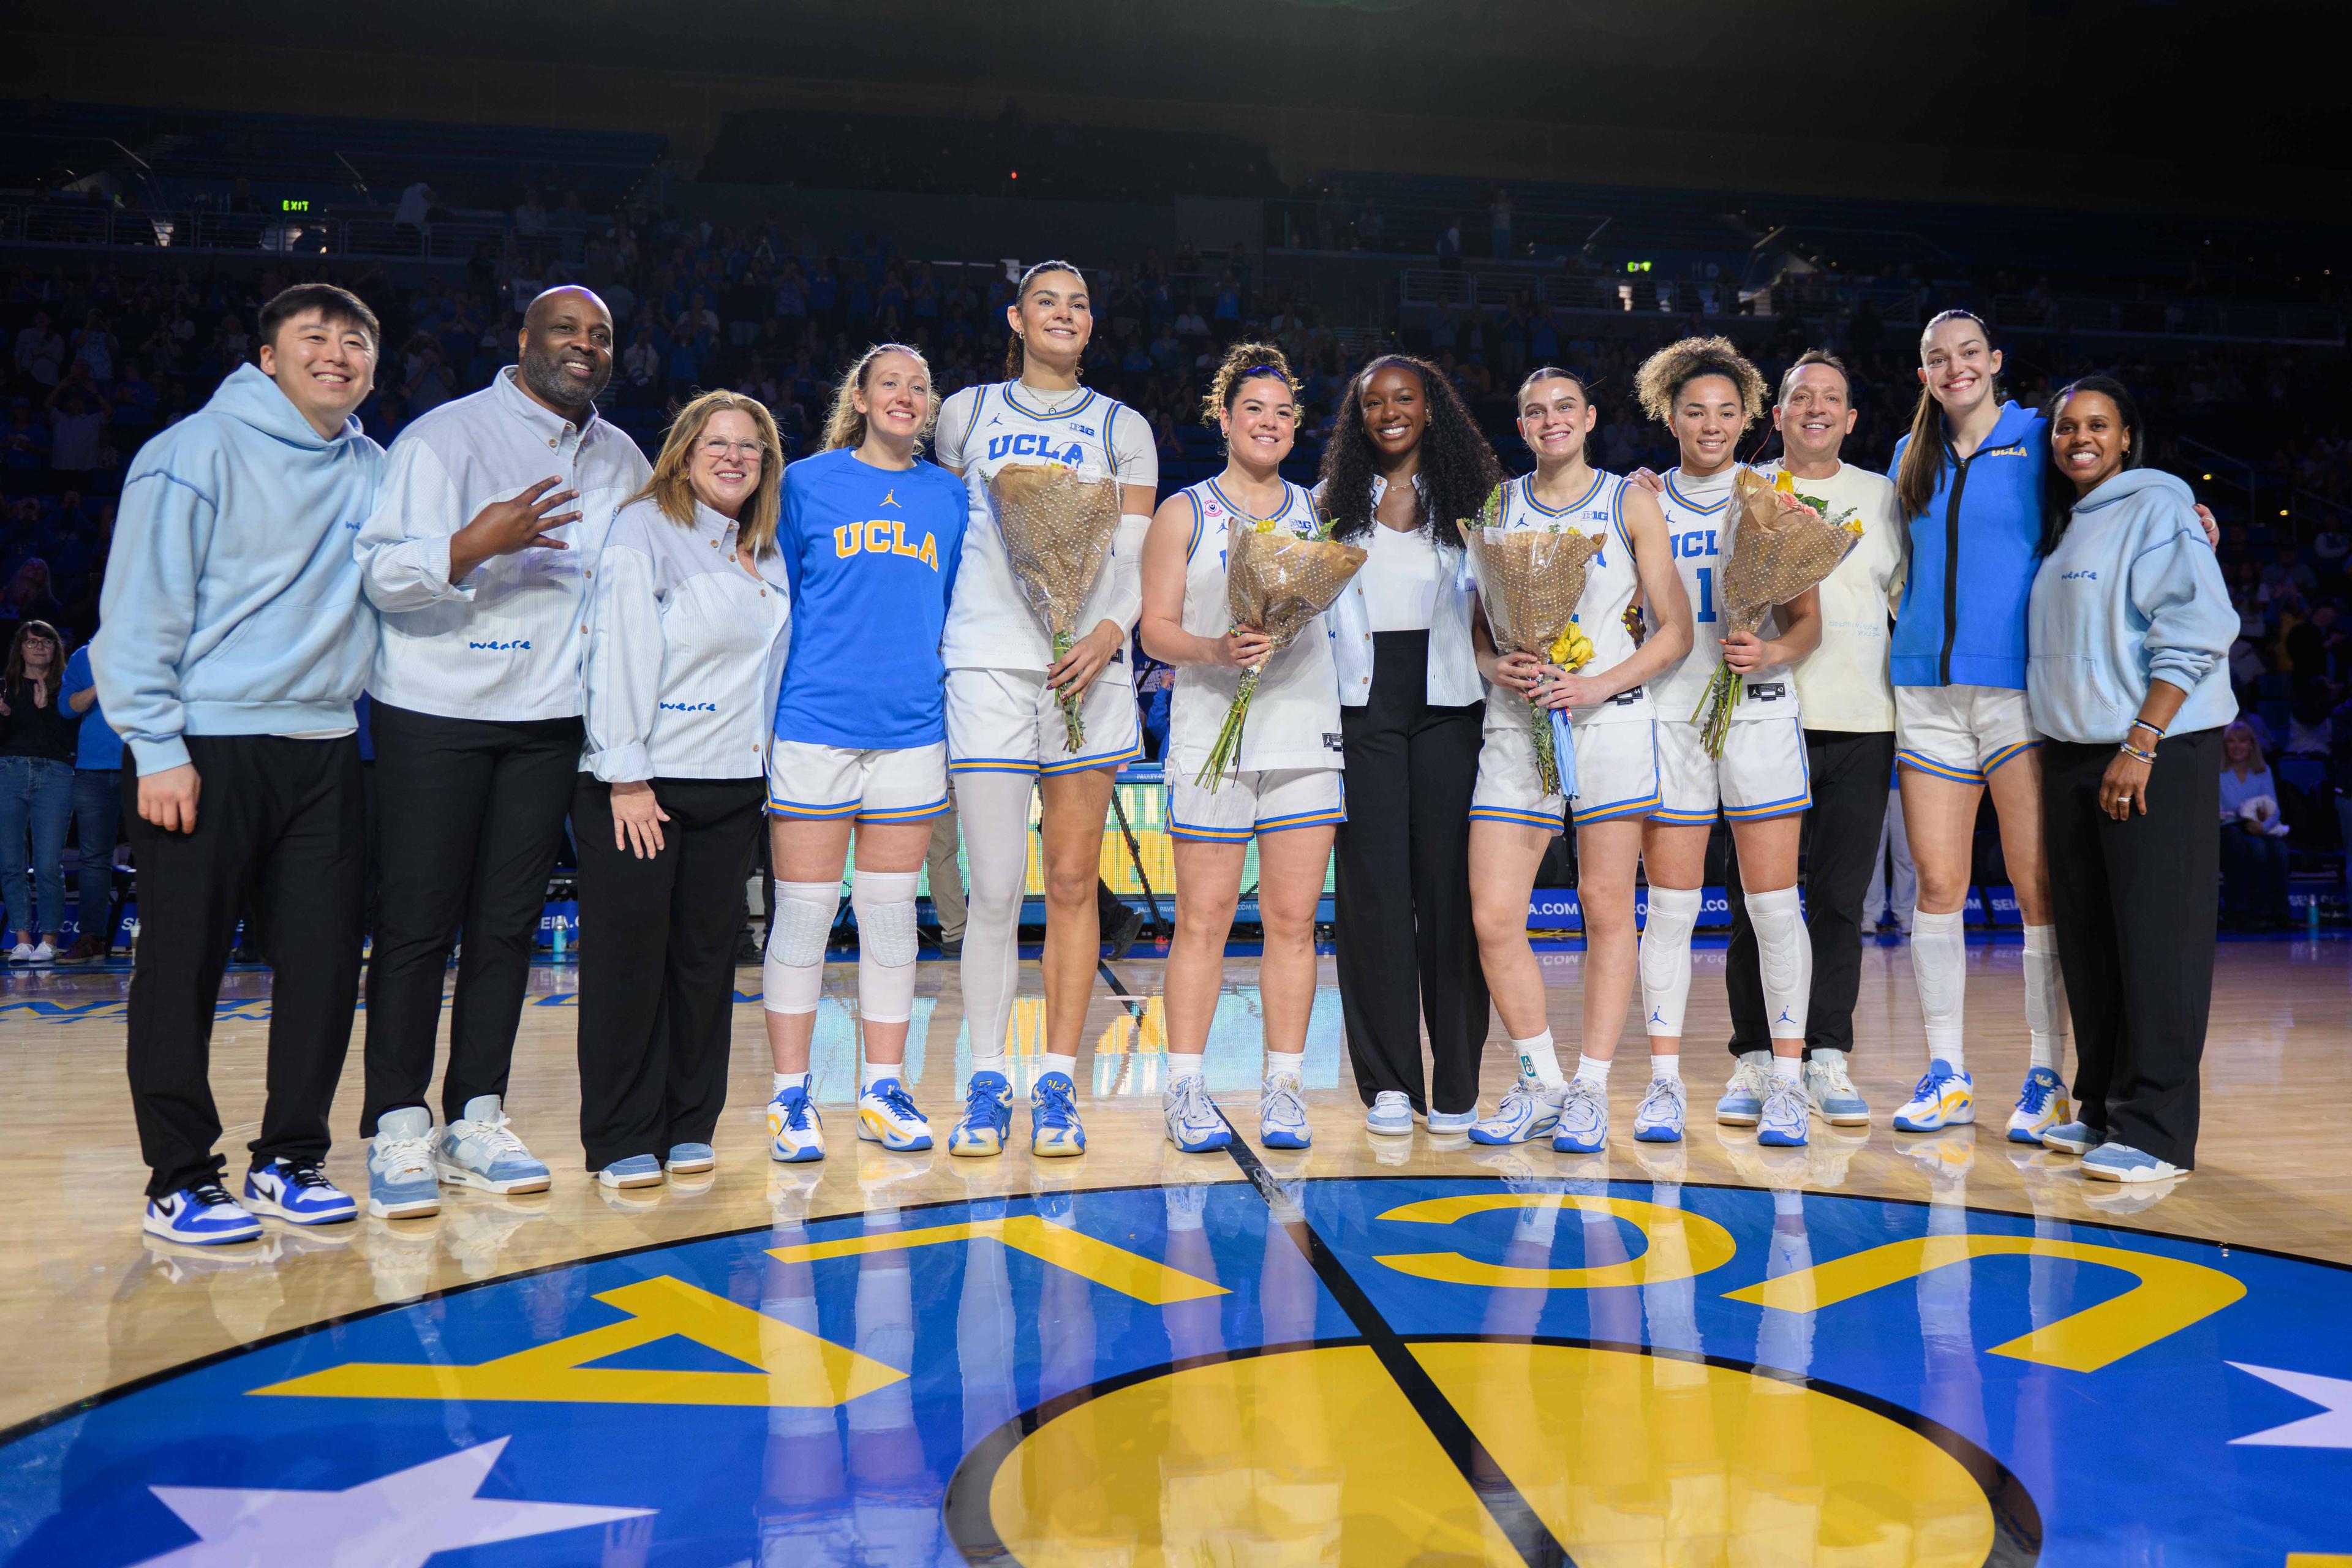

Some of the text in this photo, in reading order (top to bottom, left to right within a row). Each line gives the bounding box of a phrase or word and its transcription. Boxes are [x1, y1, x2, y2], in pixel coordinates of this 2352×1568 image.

[283, 200, 309, 211] EXIT
[988, 434, 1084, 469] UCLA
[1991, 446, 2028, 457] UCLA
[834, 519, 939, 573] UCLA
[1697, 567, 1717, 623] 1
[247, 1193, 2248, 1408] UCLA
